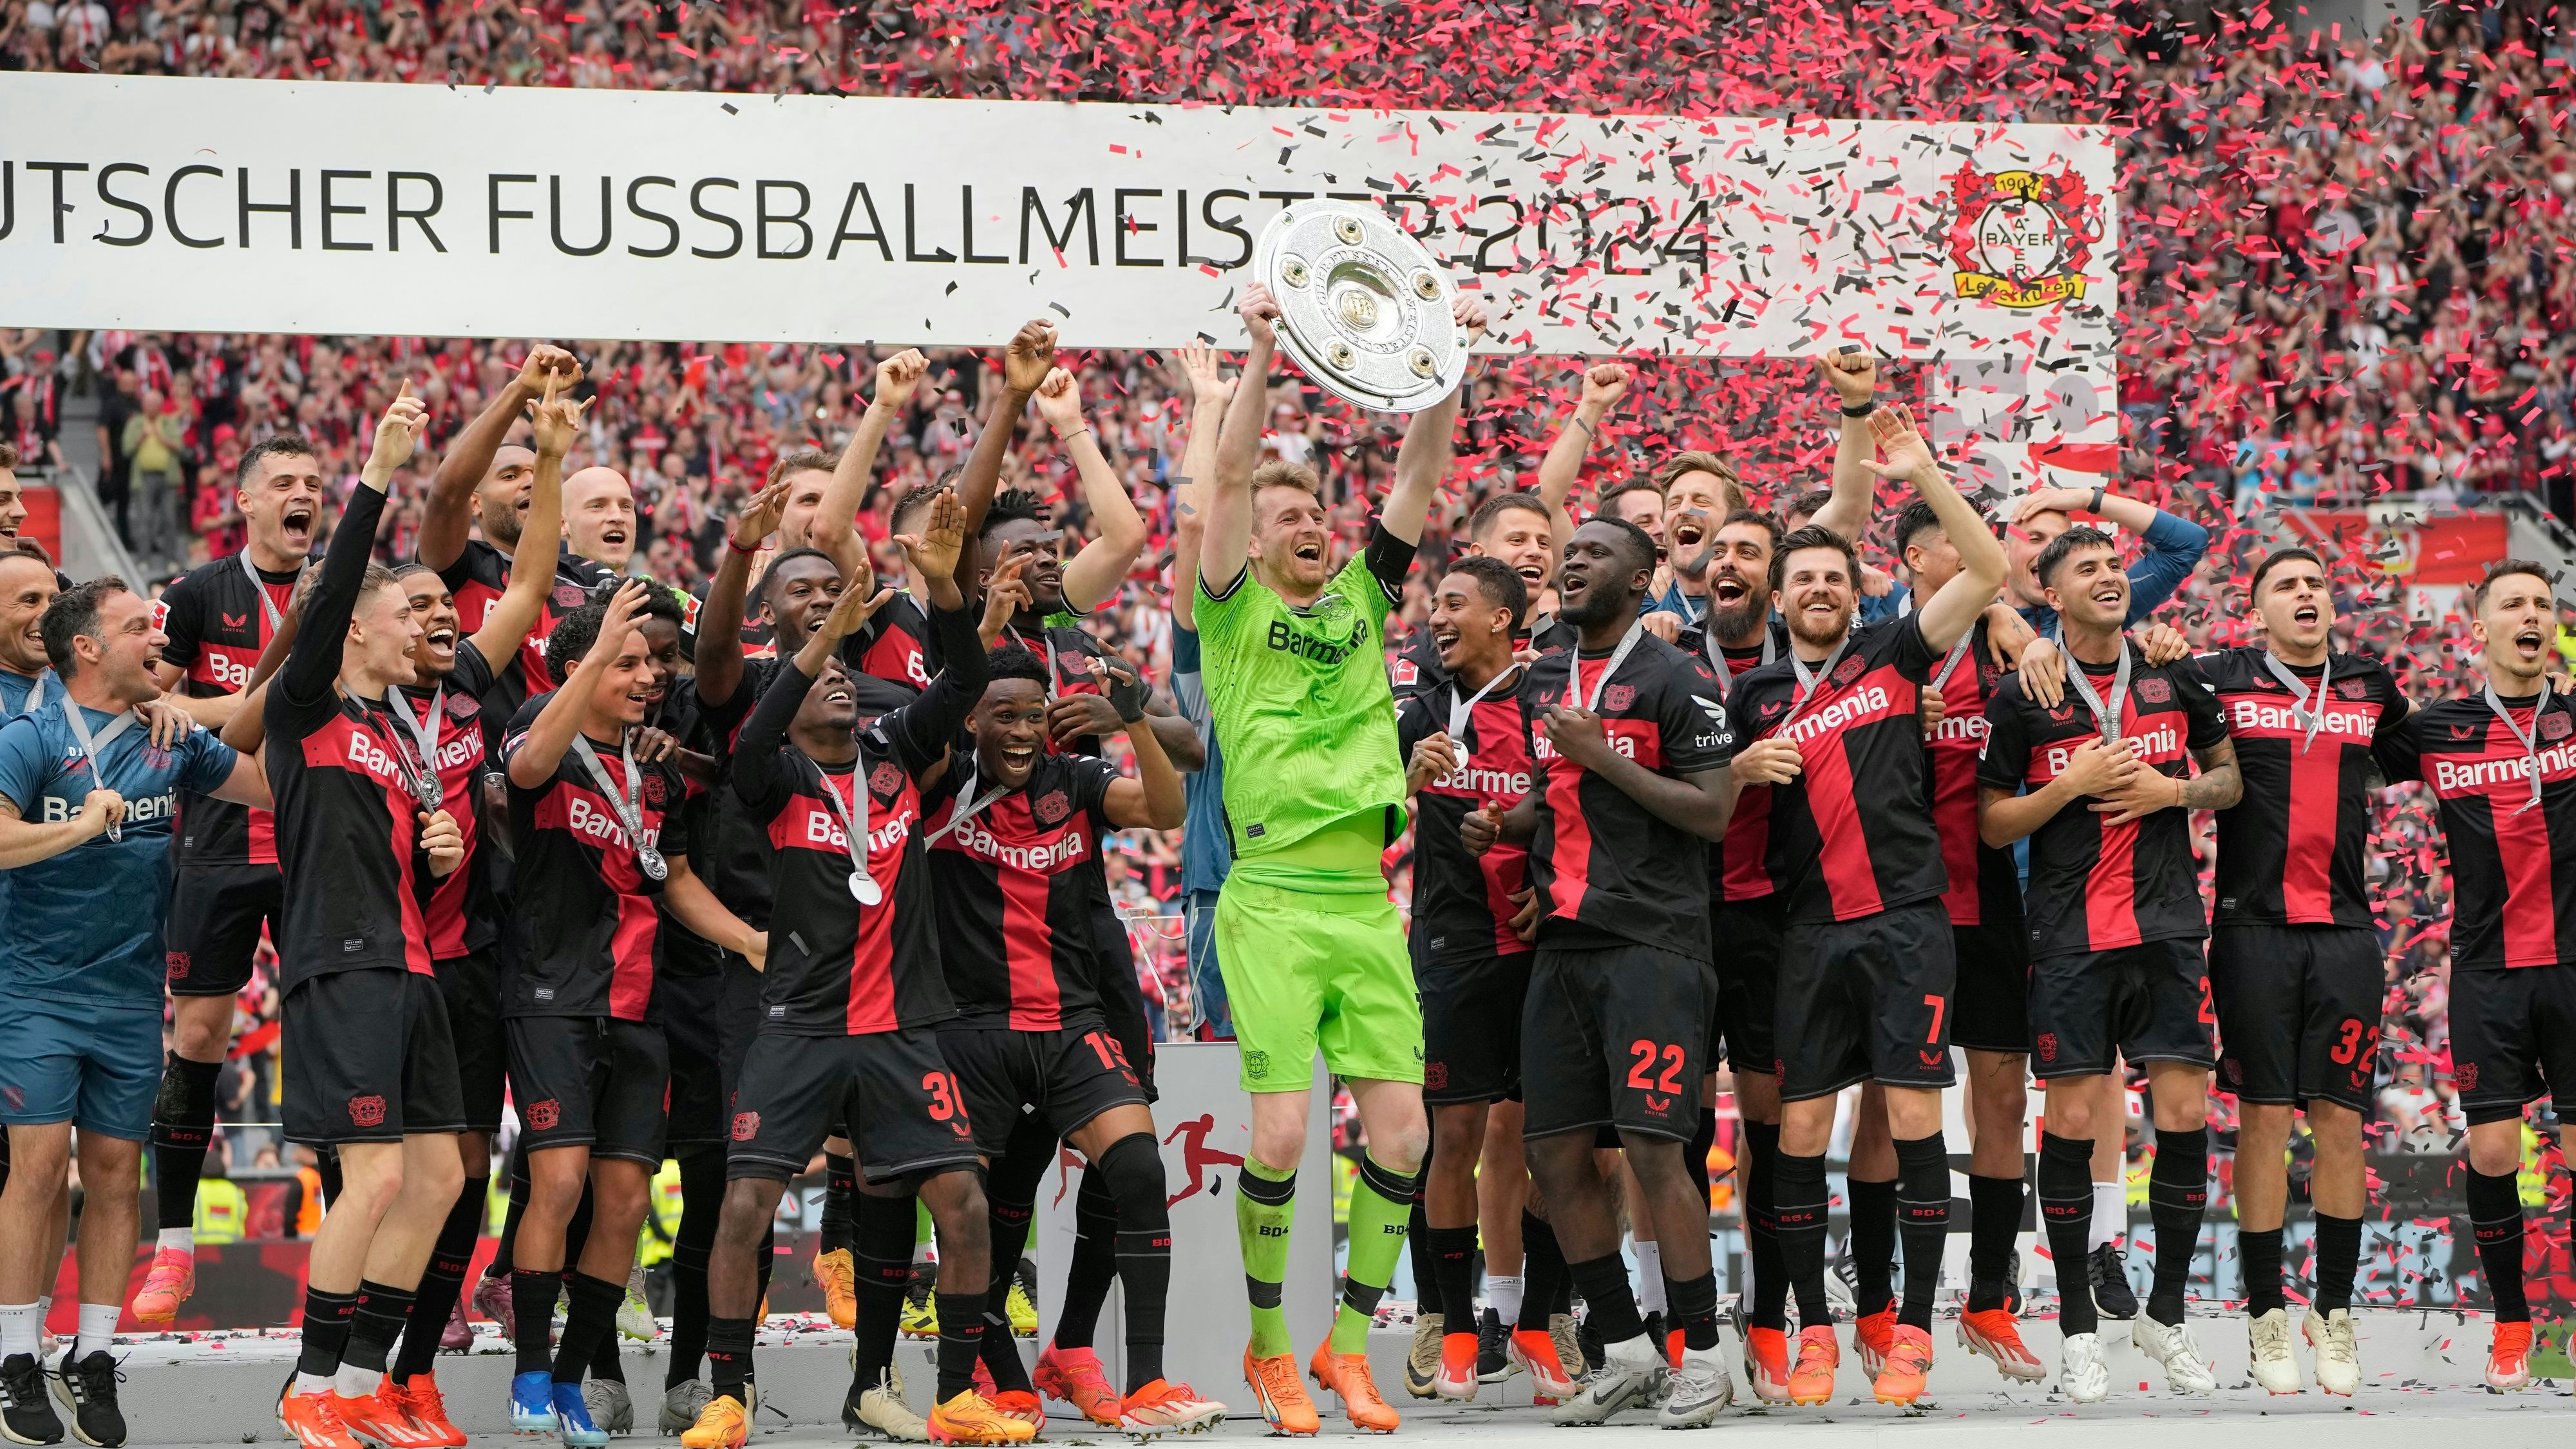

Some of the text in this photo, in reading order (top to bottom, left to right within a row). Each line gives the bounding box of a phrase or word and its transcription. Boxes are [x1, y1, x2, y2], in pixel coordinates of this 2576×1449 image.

[2000, 178, 2037, 193] 1904
[1472, 194, 1718, 277] 2024
[1986, 233, 2055, 246] BAYER
[1620, 639, 1631, 652] 2024
[2052, 719, 2076, 727] CASTORE
[1695, 731, 1733, 748] trive
[68, 746, 82, 756] DJ
[608, 784, 635, 832] BUNDESLIGA
[954, 817, 1084, 869] Barmenia
[1924, 994, 1945, 1044] 7
[2331, 1019, 2380, 1072] 32
[1627, 1039, 1686, 1094] 22
[1644, 1110, 1667, 1118] CASTORE
[2045, 1206, 2078, 1215] B04
[1152, 1238, 1171, 1247] B0
